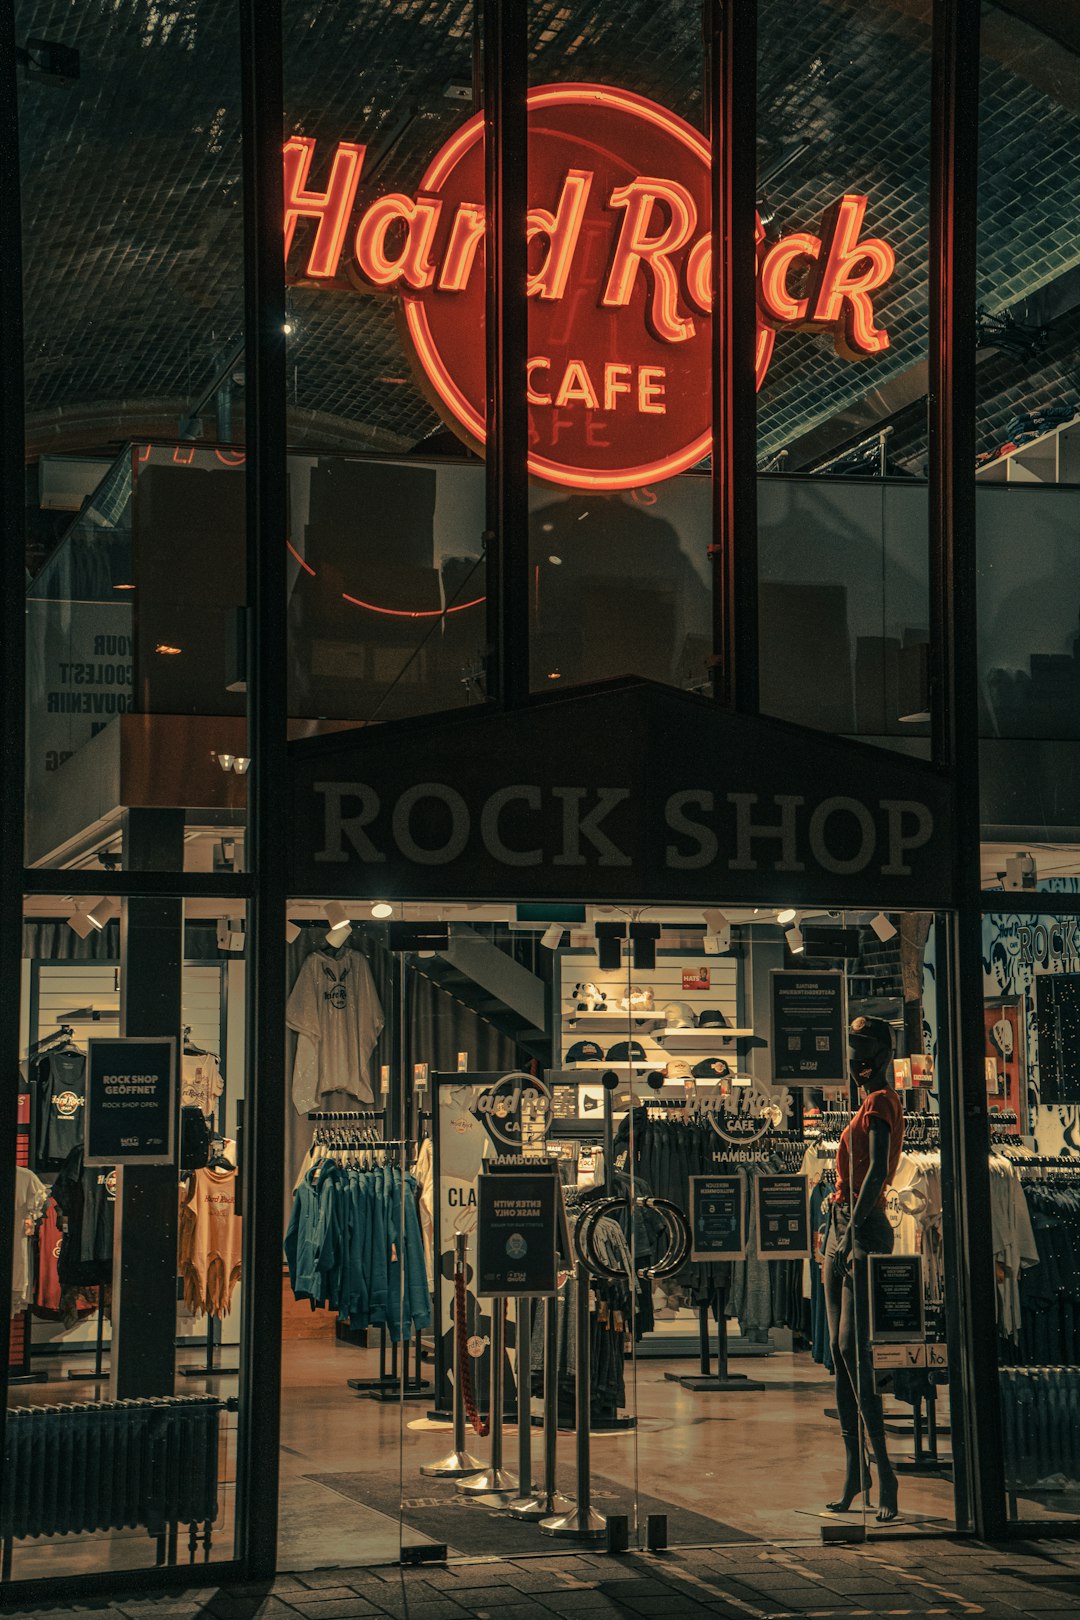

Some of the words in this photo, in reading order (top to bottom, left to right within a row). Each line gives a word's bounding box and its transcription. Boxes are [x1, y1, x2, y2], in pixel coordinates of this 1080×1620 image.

[283, 135, 594, 300] Hard
[526, 357, 667, 415] CAFE
[313, 781, 633, 867] ROCK
[664, 789, 934, 875] SHOP
[1016, 920, 1079, 964] ROCK
[102, 1075, 131, 1084] ROCK
[131, 1075, 159, 1084] SHOP
[104, 1084, 157, 1095] GEÖFFNET
[504, 1121, 533, 1132] CAFE
[726, 1120, 755, 1131] CAFE
[489, 1154, 549, 1166] HAMBURG
[712, 1151, 769, 1163] HAMBURG
